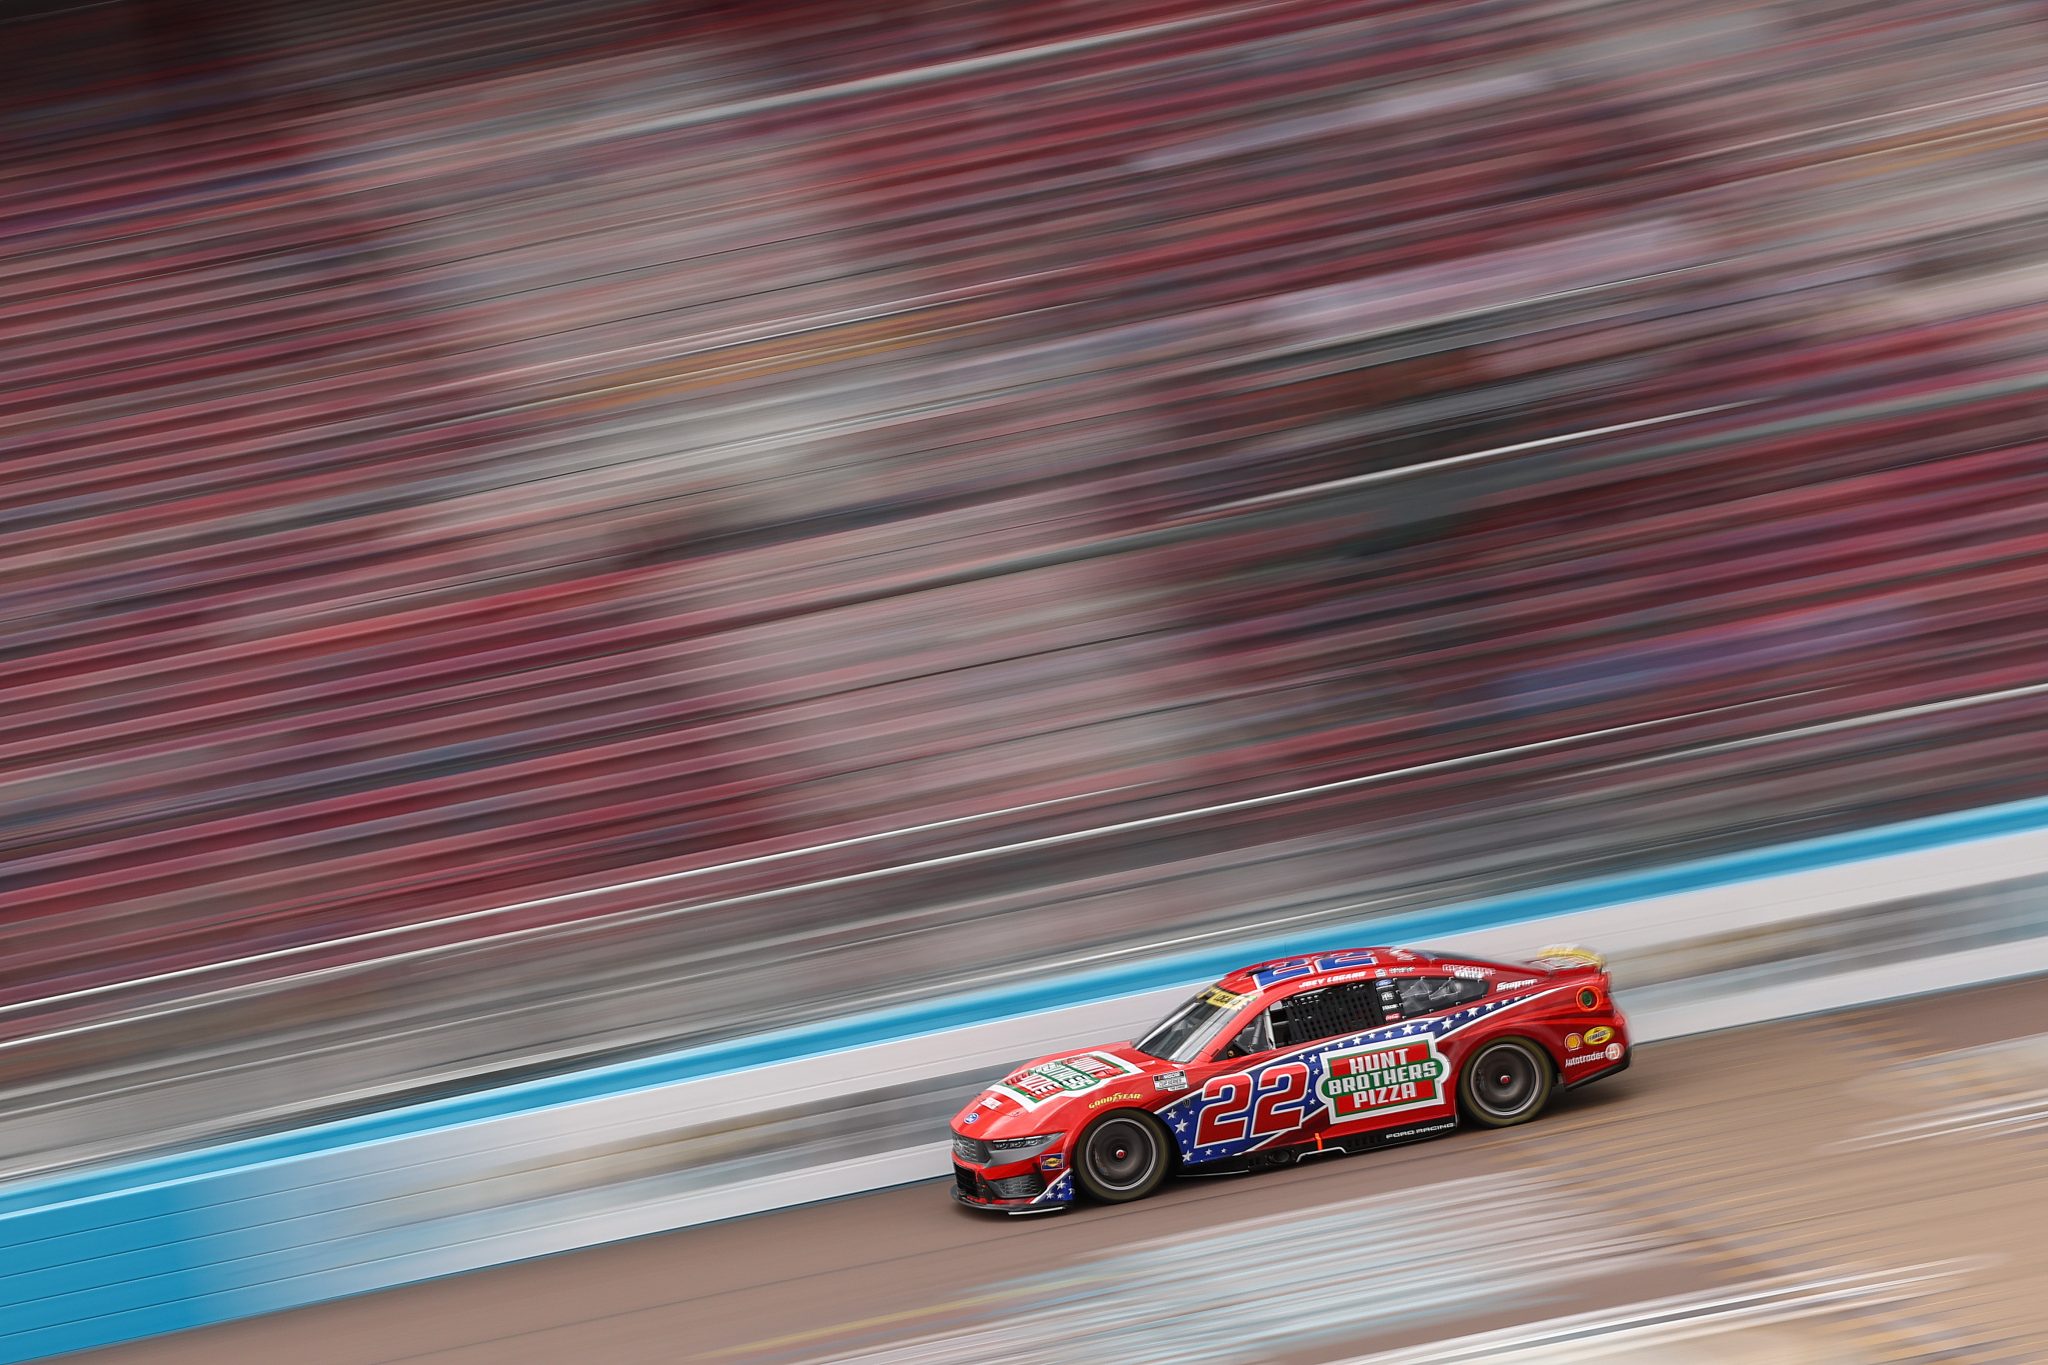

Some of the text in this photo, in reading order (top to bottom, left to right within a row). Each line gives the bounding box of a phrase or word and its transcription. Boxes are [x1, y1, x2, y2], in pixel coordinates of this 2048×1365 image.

[1240, 951, 1378, 991] 22
[1349, 1048, 1409, 1075] HUNT
[1327, 1061, 1438, 1094] BROTHERS
[1088, 1092, 1142, 1109] GOODYEAR
[1193, 1061, 1310, 1149] 22
[1353, 1081, 1418, 1109] PIZZA
[1385, 1122, 1455, 1139] FORD RACING
